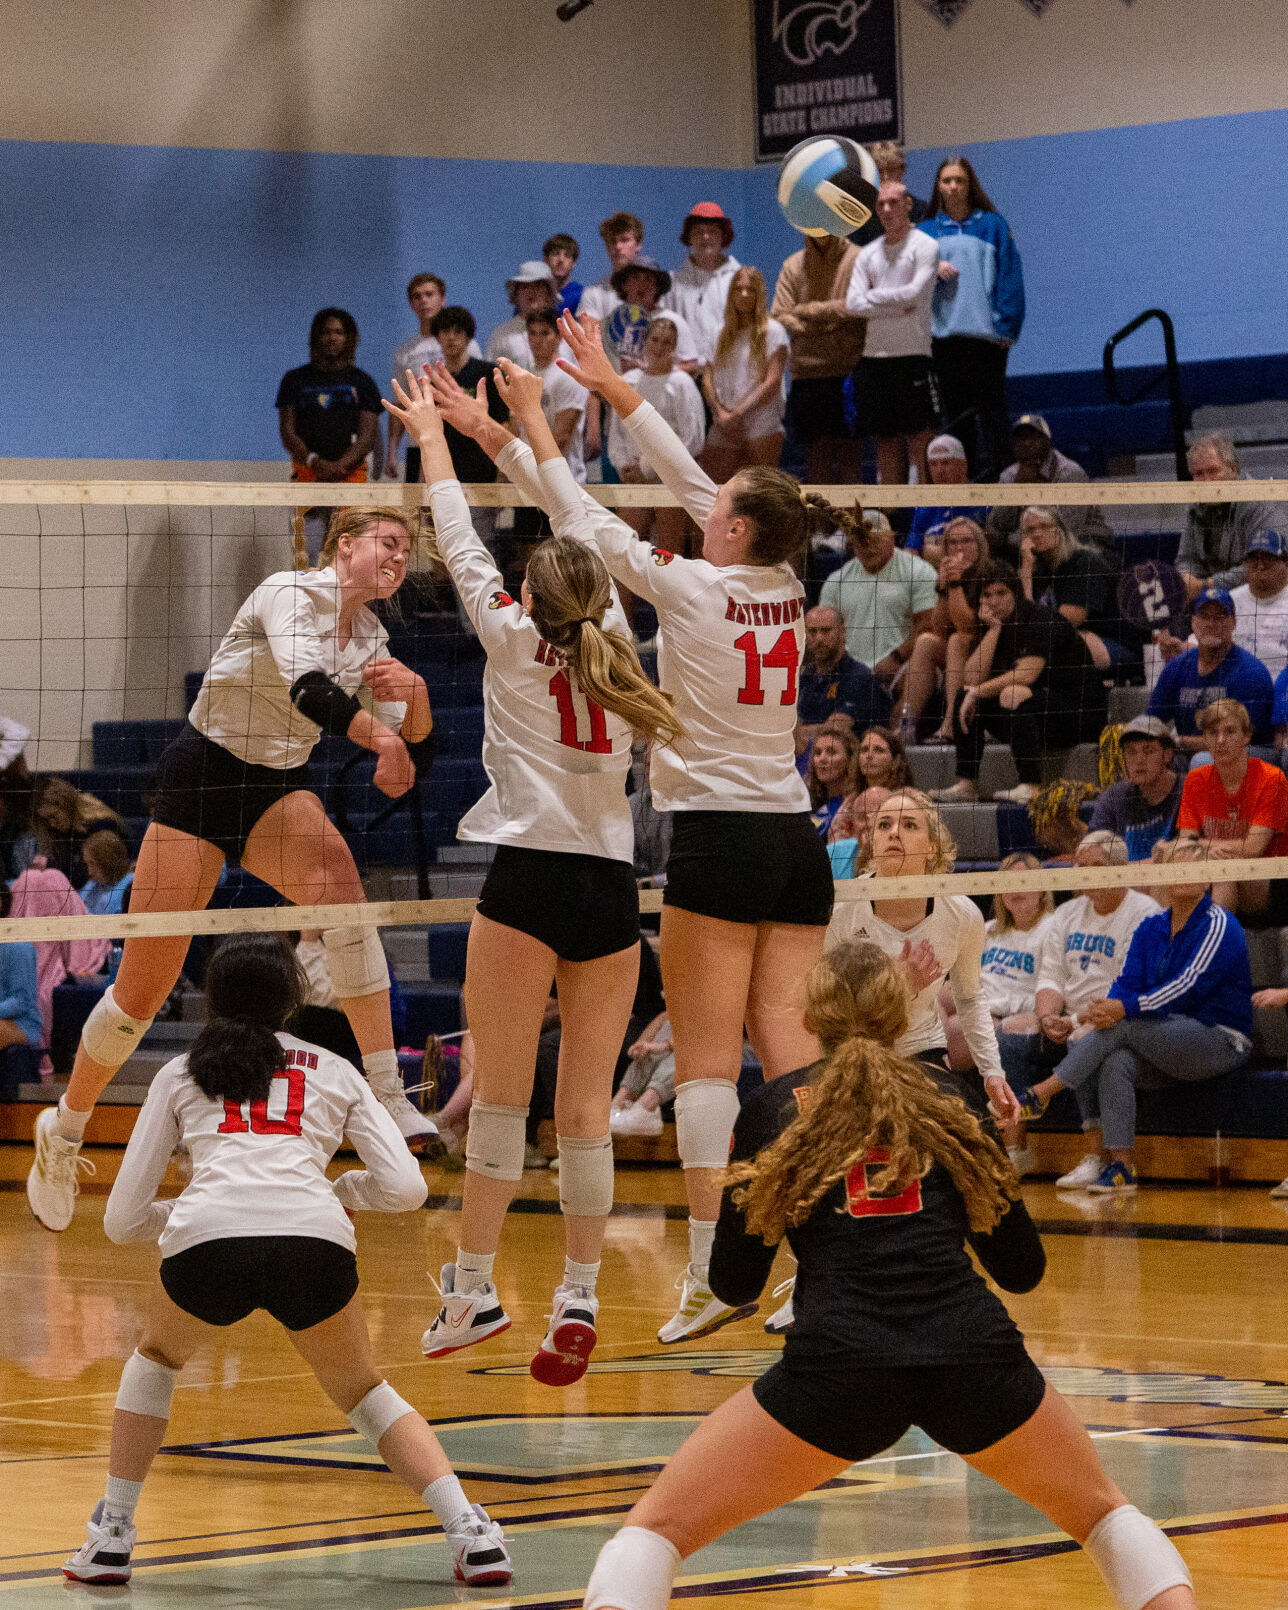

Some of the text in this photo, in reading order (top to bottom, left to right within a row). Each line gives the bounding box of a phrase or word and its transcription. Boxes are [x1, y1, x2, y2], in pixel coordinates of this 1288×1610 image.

[763, 99, 893, 137] STATE CHAMPIONS
[774, 72, 878, 109] INDIVIDUAL
[733, 628, 800, 706] 14
[548, 666, 613, 755] 11
